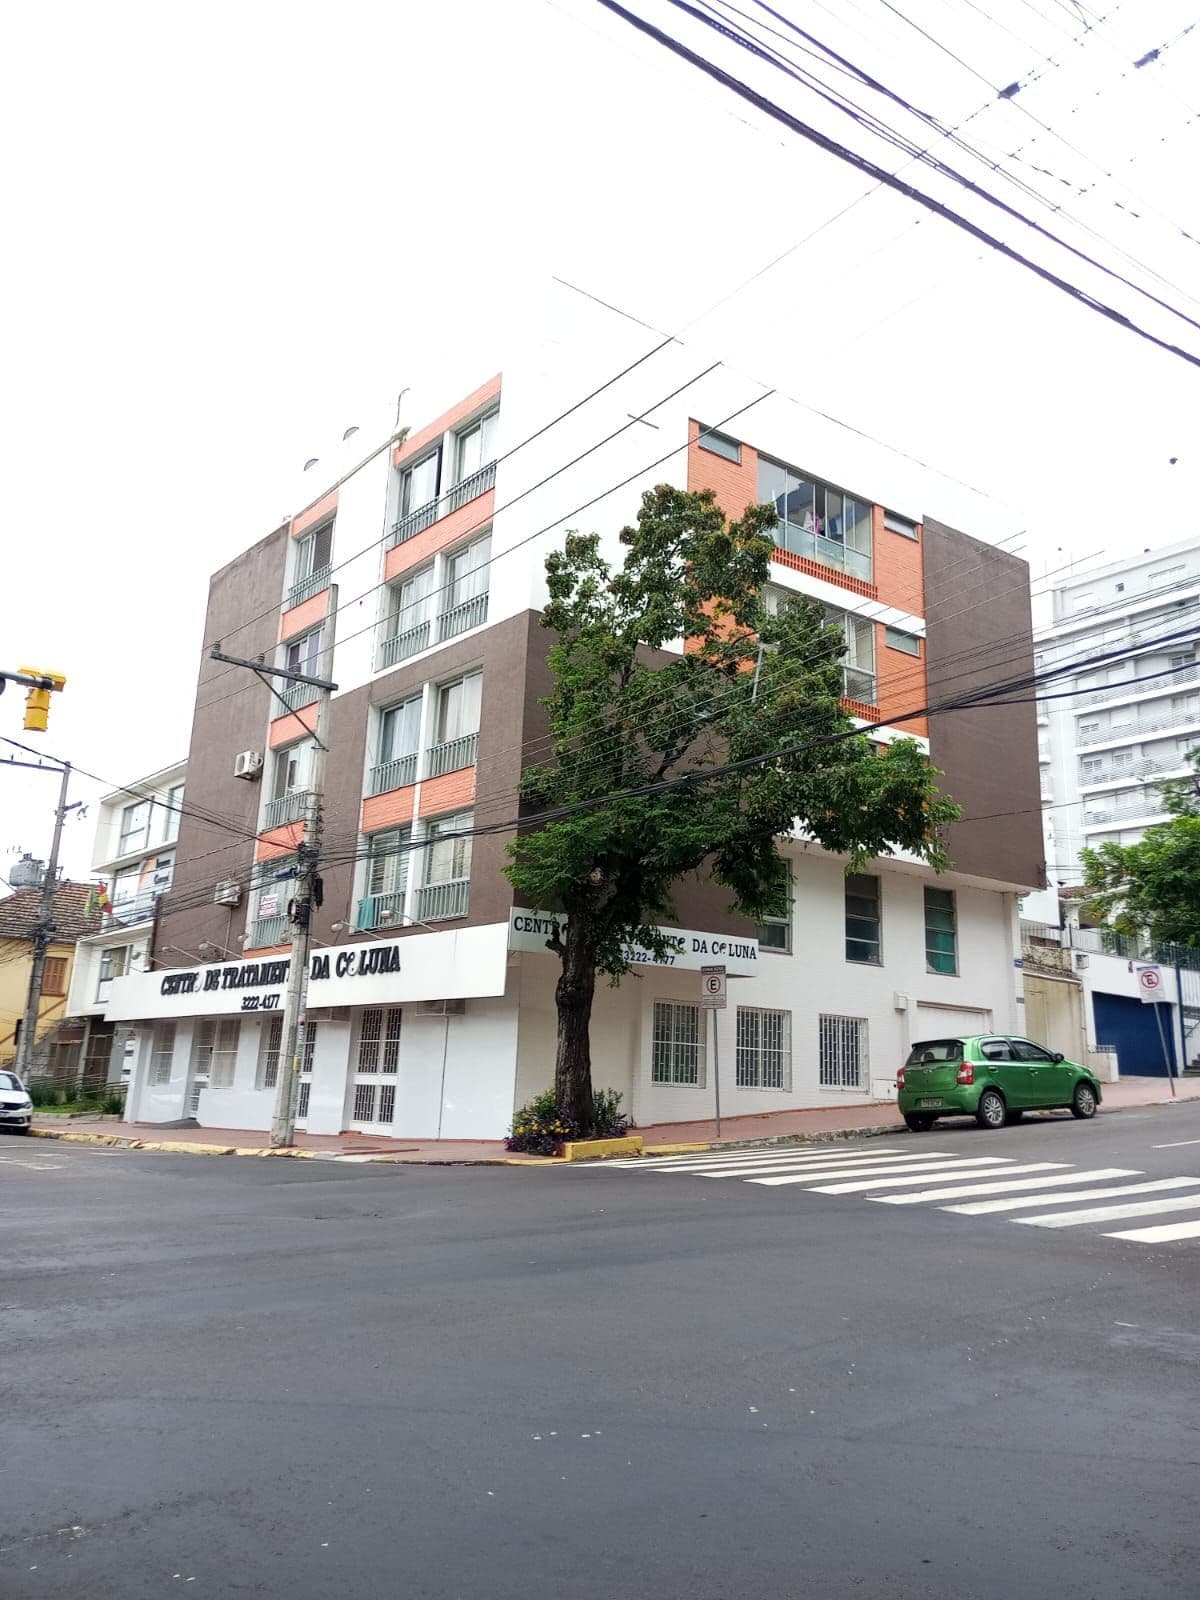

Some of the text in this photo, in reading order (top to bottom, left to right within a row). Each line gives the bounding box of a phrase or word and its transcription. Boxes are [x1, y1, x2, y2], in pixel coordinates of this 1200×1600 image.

[692, 938, 708, 954] DA
[711, 941, 757, 960] COLUNA
[203, 969, 221, 991] DE
[221, 959, 291, 990] TRATAMENT
[310, 954, 330, 980] DA
[336, 945, 401, 978] COLUNA
[710, 979, 717, 991] E
